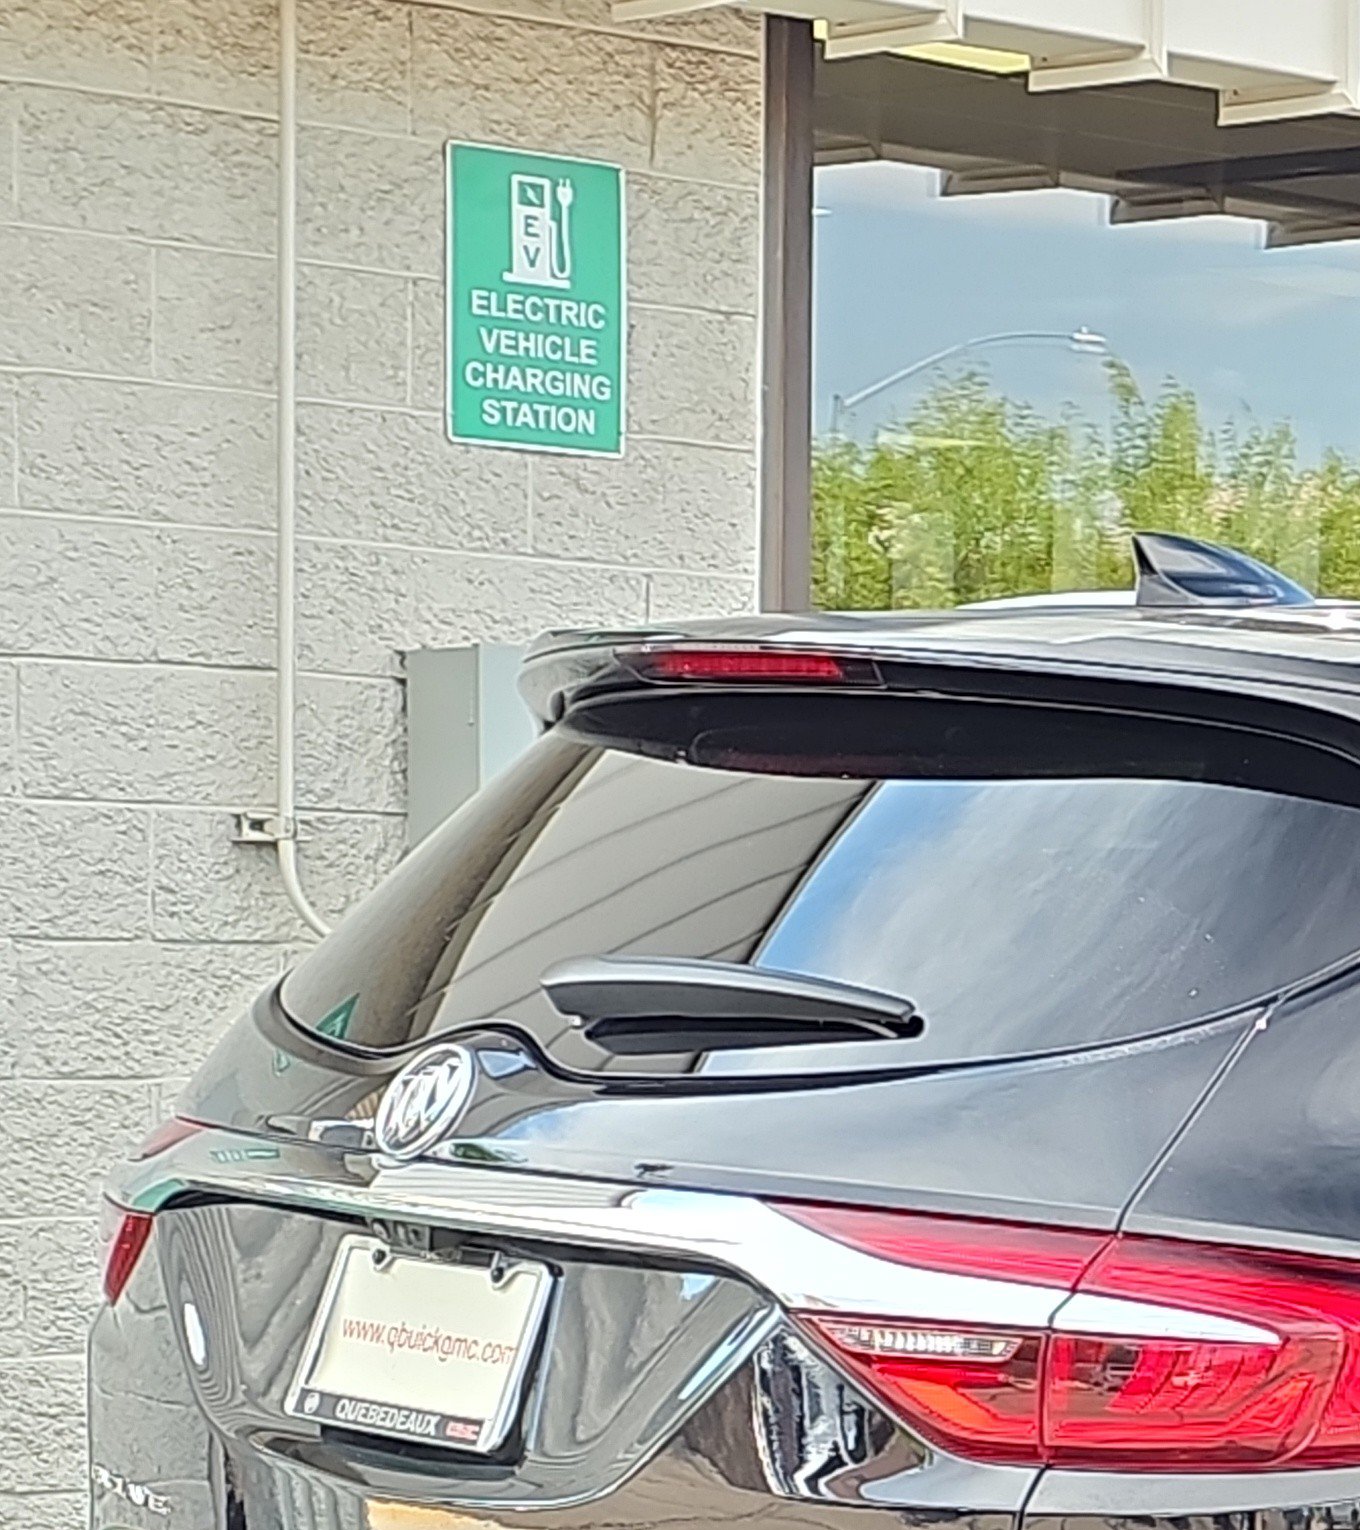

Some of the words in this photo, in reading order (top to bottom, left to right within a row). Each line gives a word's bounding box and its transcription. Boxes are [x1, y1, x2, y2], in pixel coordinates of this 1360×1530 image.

[522, 214, 542, 269] EV
[471, 289, 606, 329] ELECTRIC
[480, 327, 598, 365] VEHICLE
[465, 361, 611, 400] CHARGING
[482, 399, 596, 435] STATION
[334, 1399, 440, 1436] QUEBEDEAUX
